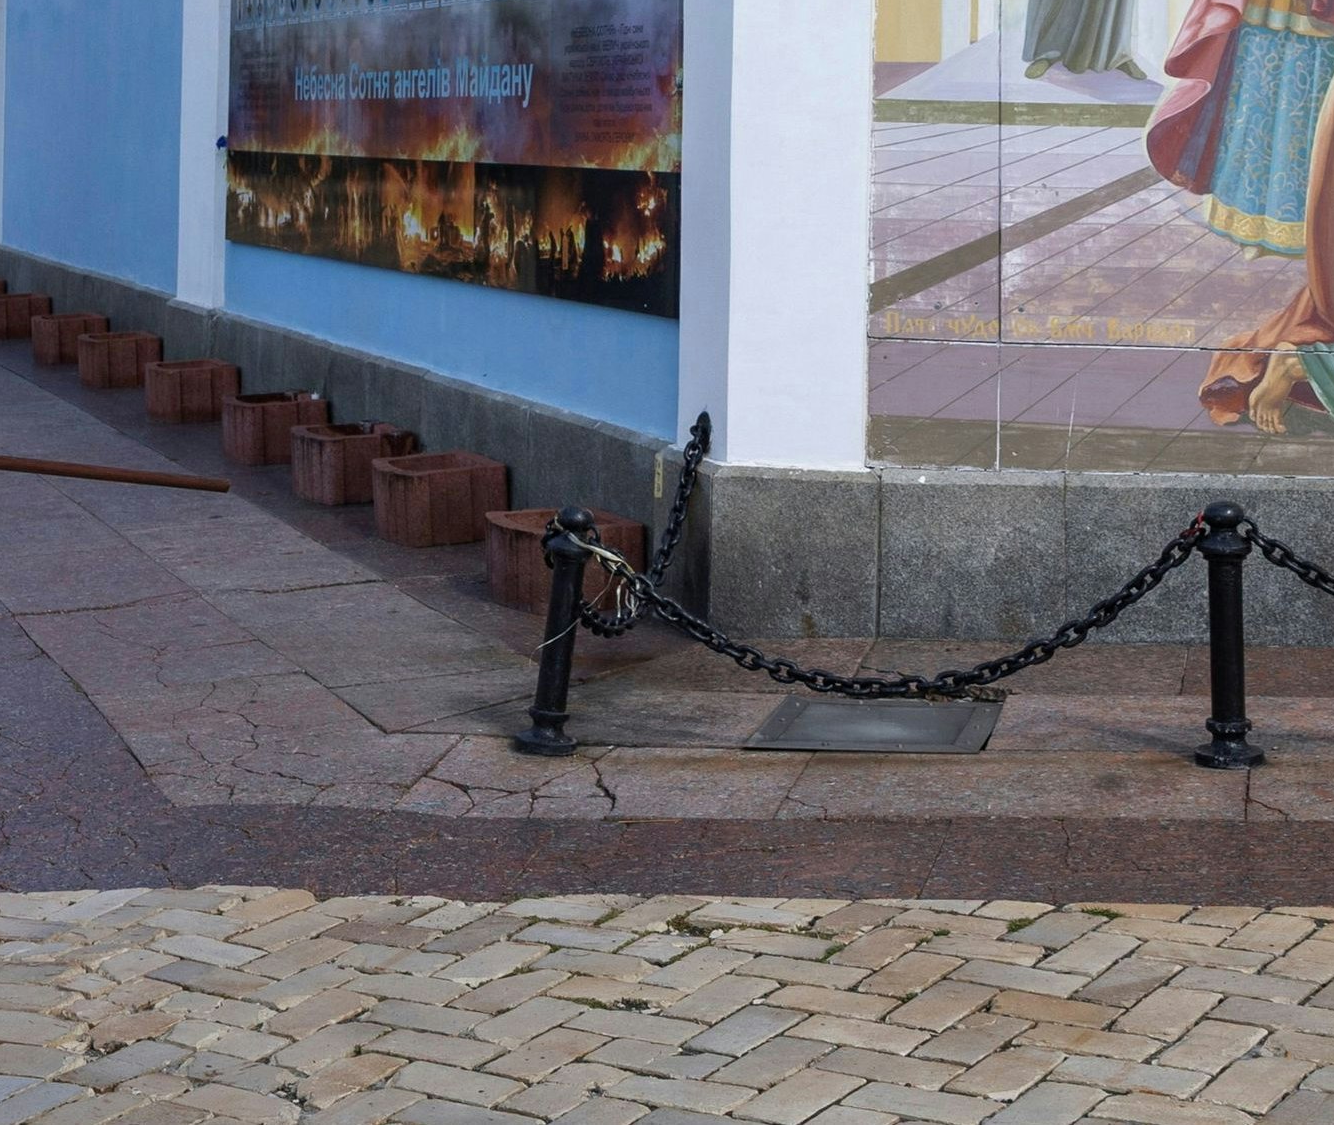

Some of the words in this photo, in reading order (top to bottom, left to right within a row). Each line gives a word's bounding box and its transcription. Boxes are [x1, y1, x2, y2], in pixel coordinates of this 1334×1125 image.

[294, 65, 346, 102] Небесна
[348, 61, 389, 100] Сотня
[393, 58, 451, 100] ангелів
[455, 53, 534, 109] Майдану
